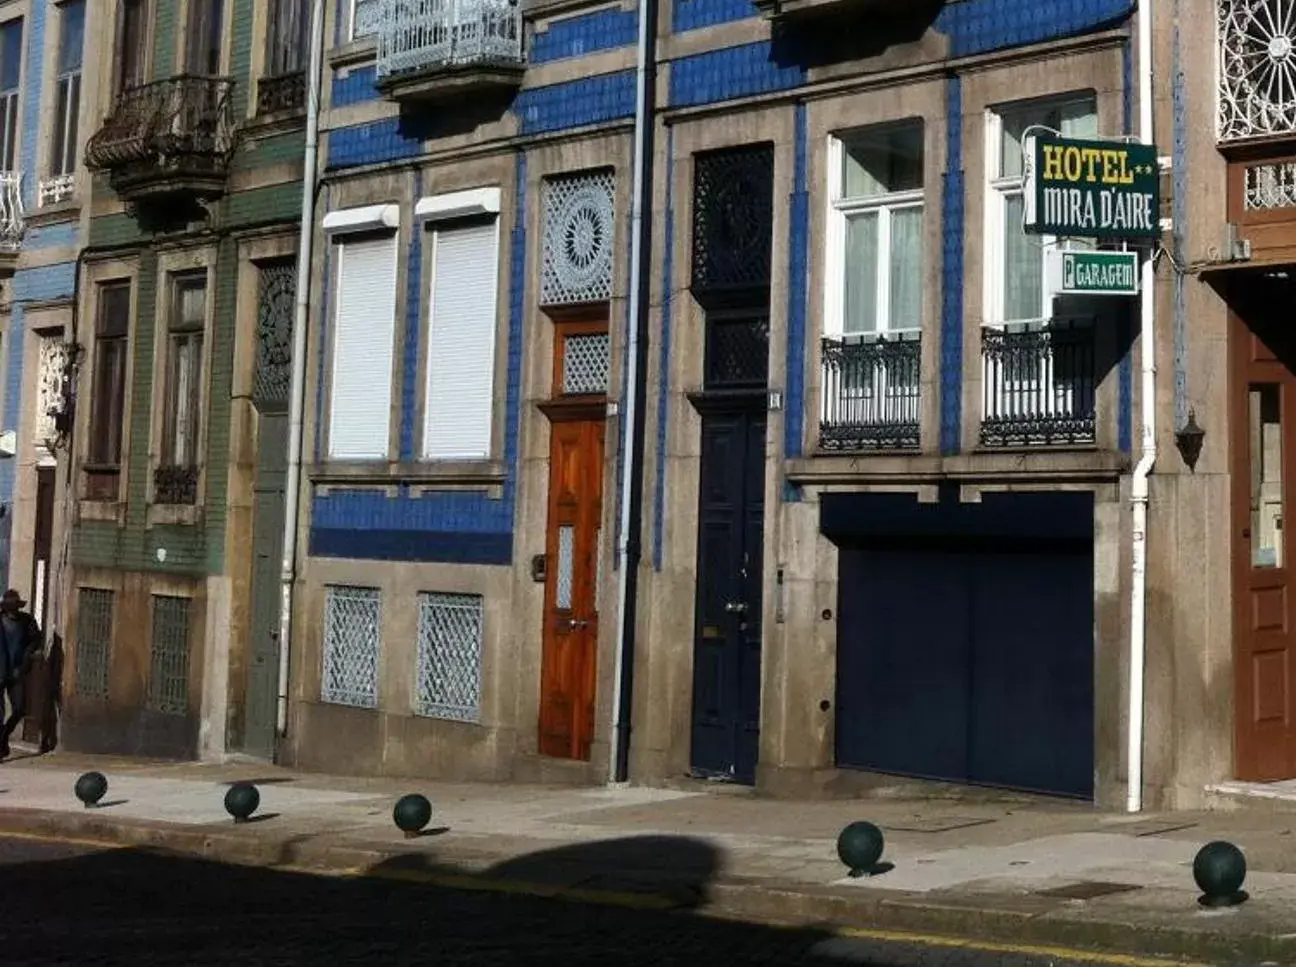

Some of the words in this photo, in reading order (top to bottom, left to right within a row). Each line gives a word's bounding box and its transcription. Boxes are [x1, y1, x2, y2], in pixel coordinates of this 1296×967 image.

[1043, 145, 1134, 184] HOTEL
[1044, 187, 1096, 229] MIRA
[1100, 187, 1154, 230] D'AIRE
[1076, 263, 1133, 288] GARAGEM
